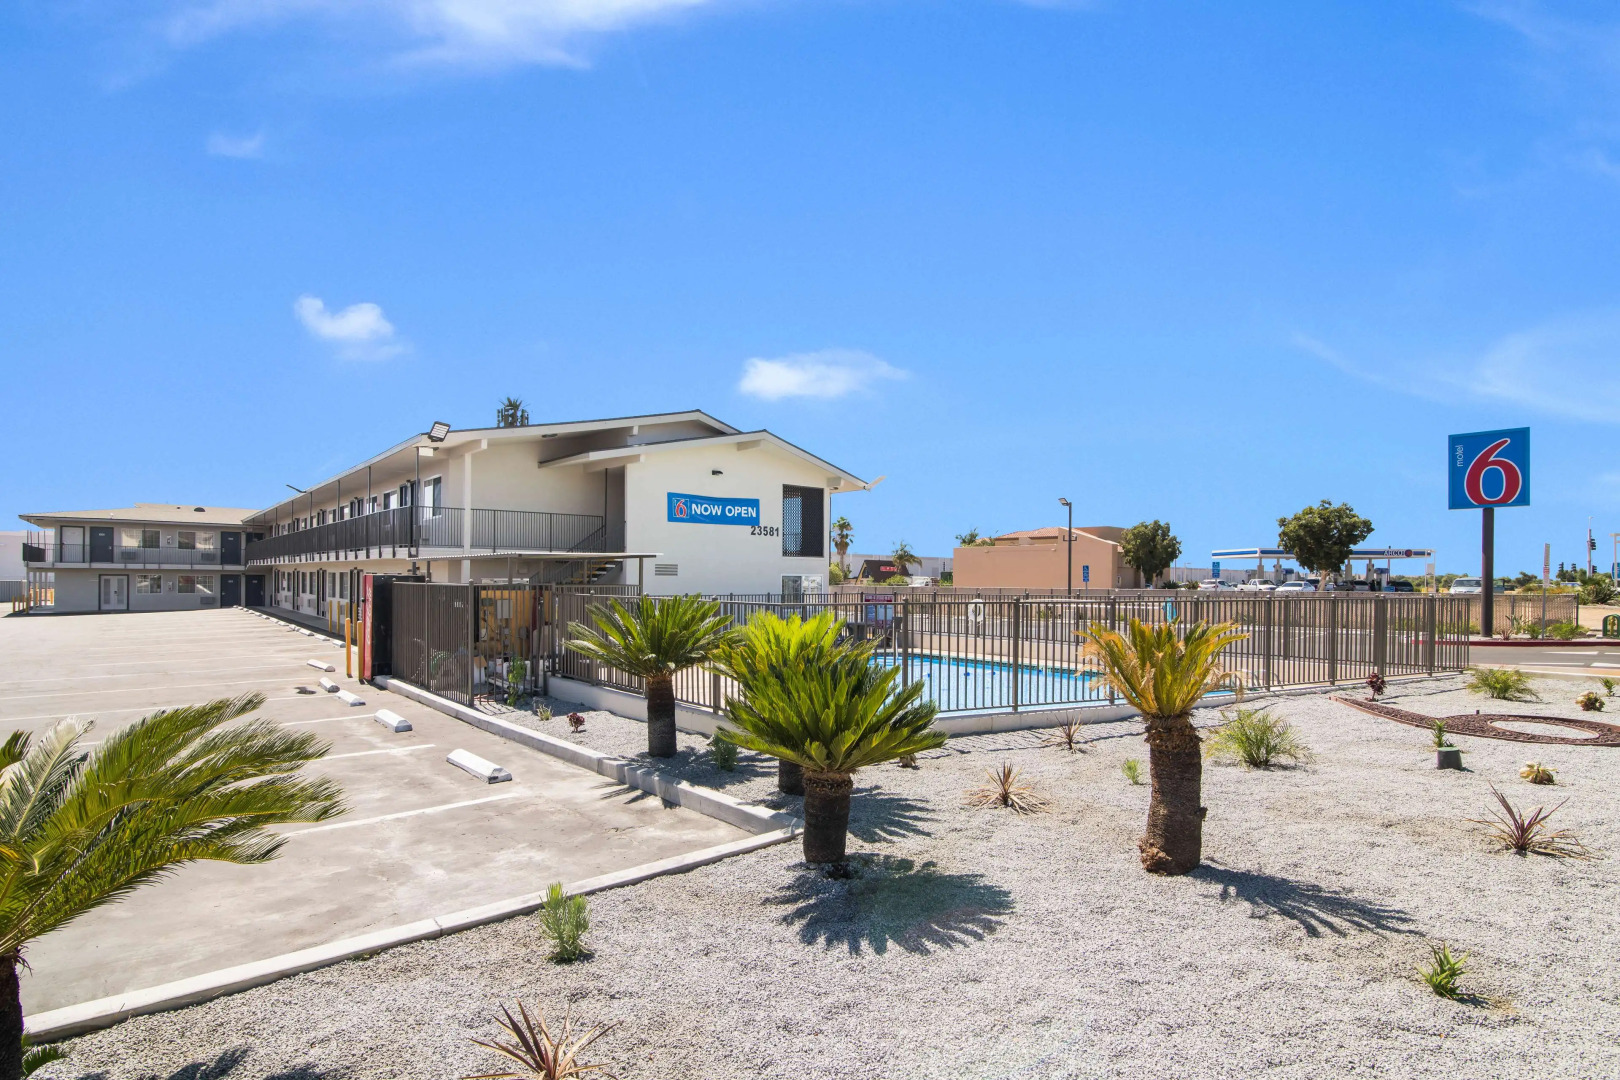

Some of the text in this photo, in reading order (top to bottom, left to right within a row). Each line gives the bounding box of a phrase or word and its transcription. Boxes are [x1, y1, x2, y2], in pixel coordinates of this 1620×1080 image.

[1455, 438, 1522, 505] motel 6
[675, 500, 687, 517] 6
[691, 503, 722, 516] NOW
[725, 506, 757, 518] OPEN
[750, 525, 779, 537] 23581
